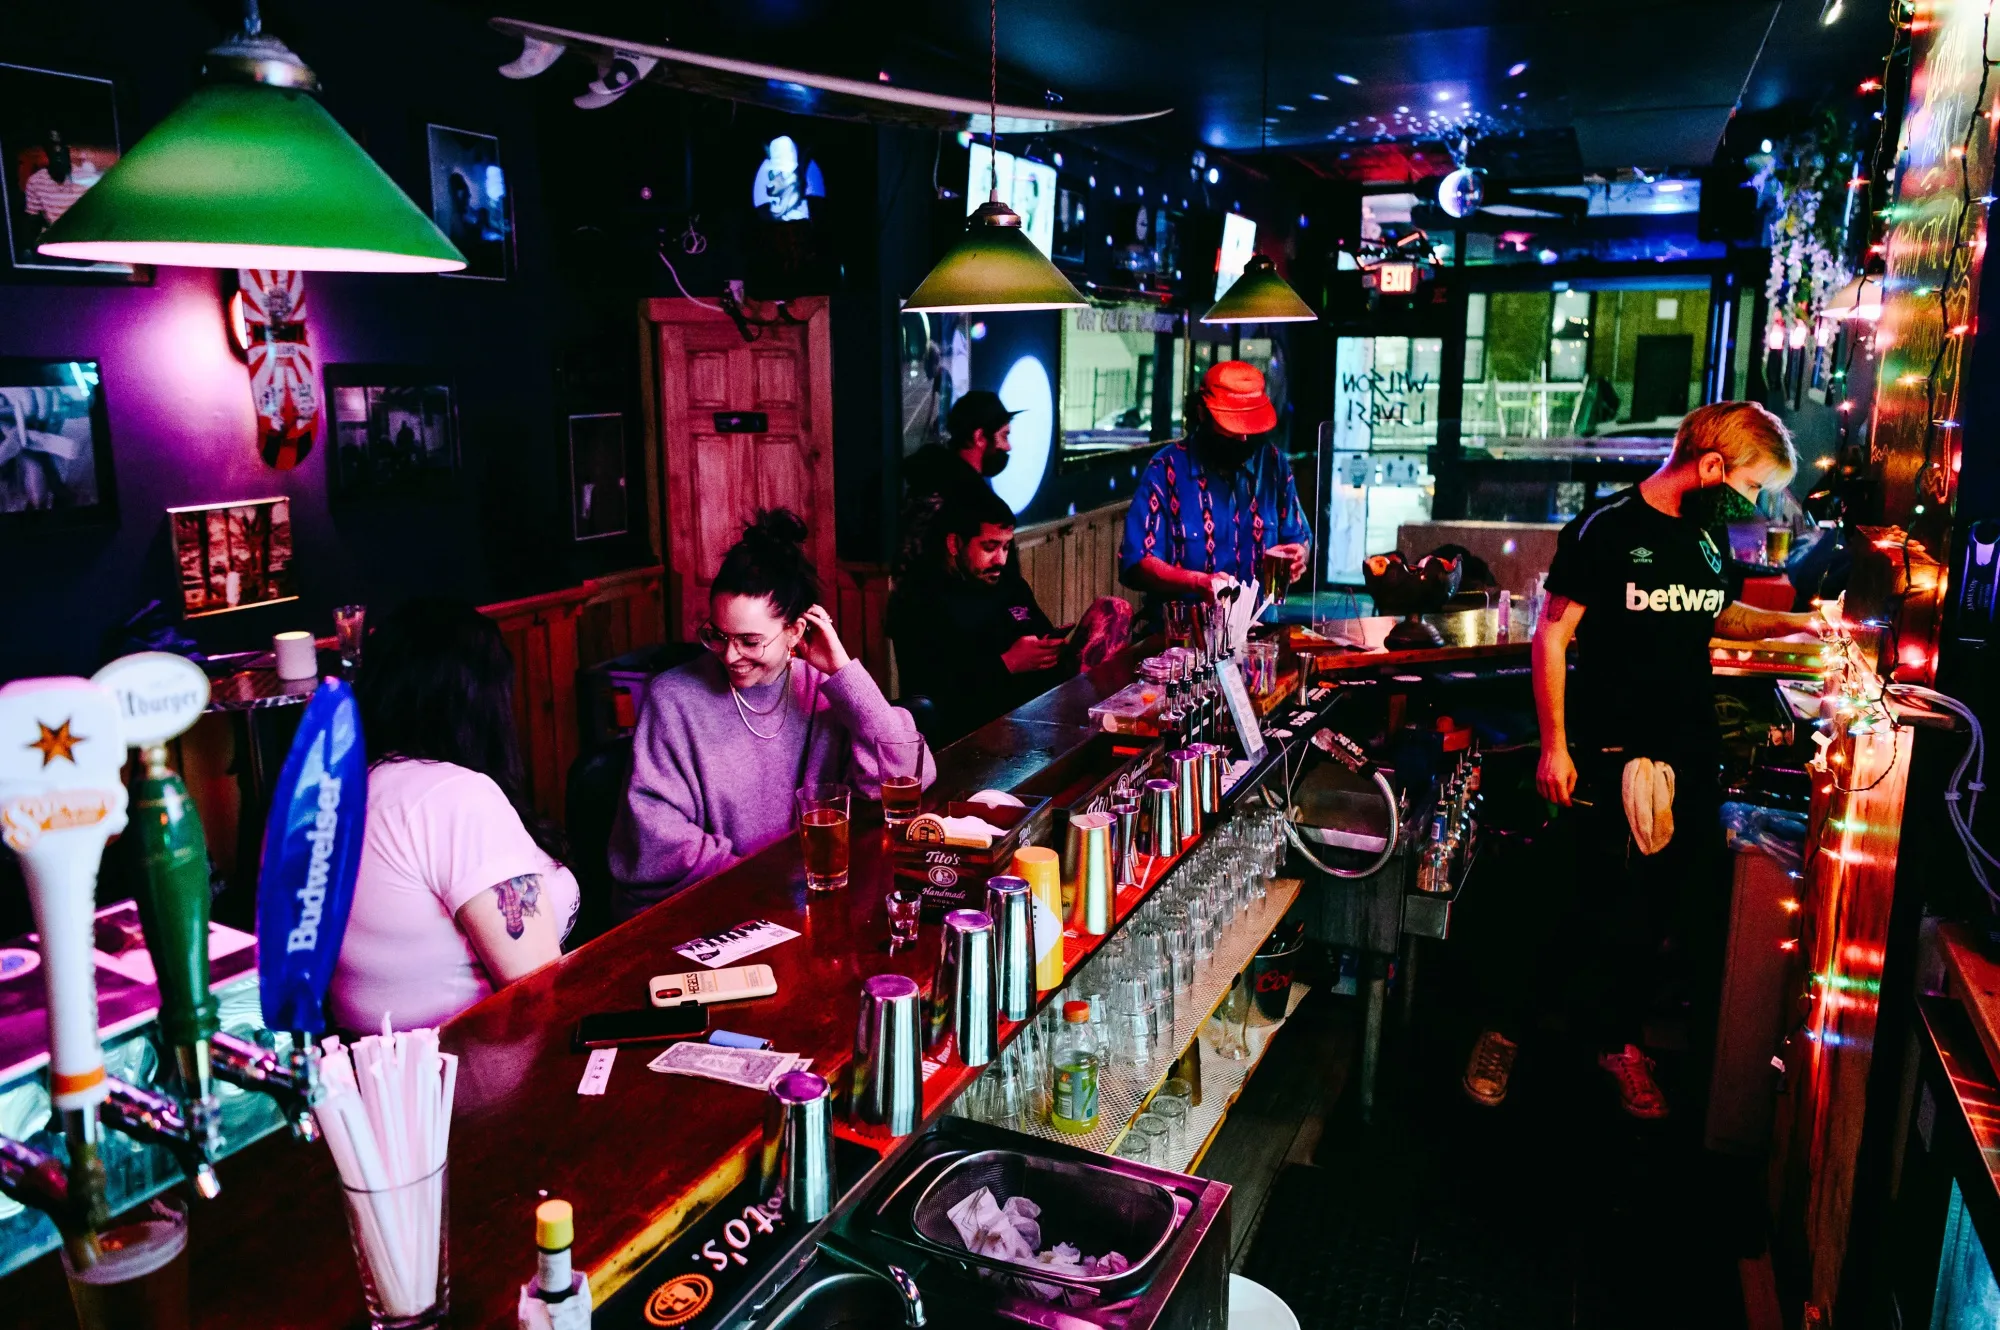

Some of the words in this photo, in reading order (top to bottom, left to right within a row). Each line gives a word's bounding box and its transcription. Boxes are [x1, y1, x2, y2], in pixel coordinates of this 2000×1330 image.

[1380, 266, 1413, 292] EXIT
[1626, 582, 1725, 618] betway
[286, 772, 342, 953] Budweiser
[925, 851, 960, 865] Tito's
[921, 886, 966, 900] Handmade
[686, 973, 700, 994] HEGELS
